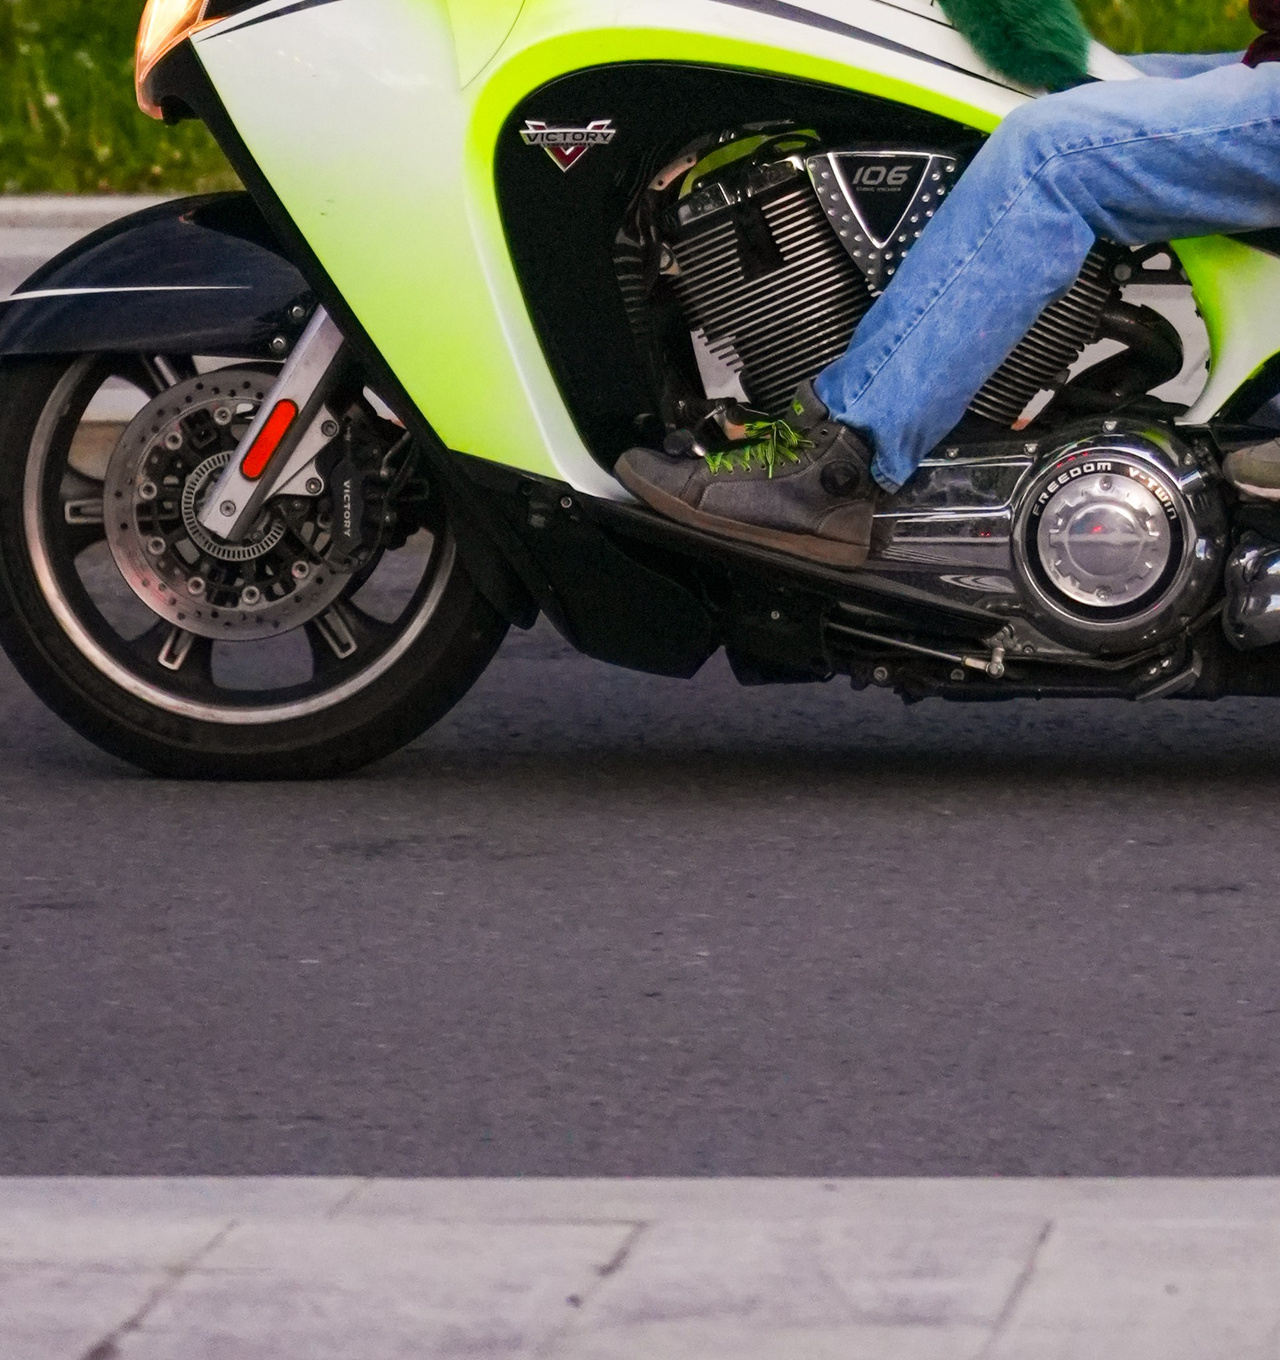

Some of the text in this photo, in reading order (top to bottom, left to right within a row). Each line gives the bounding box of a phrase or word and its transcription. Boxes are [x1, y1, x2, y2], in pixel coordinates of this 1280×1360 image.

[526, 131, 611, 143] VICTORY
[851, 165, 913, 186] 106
[342, 478, 352, 538] VICTORY
[1031, 461, 1178, 521] FREEDOM V-TWIN
